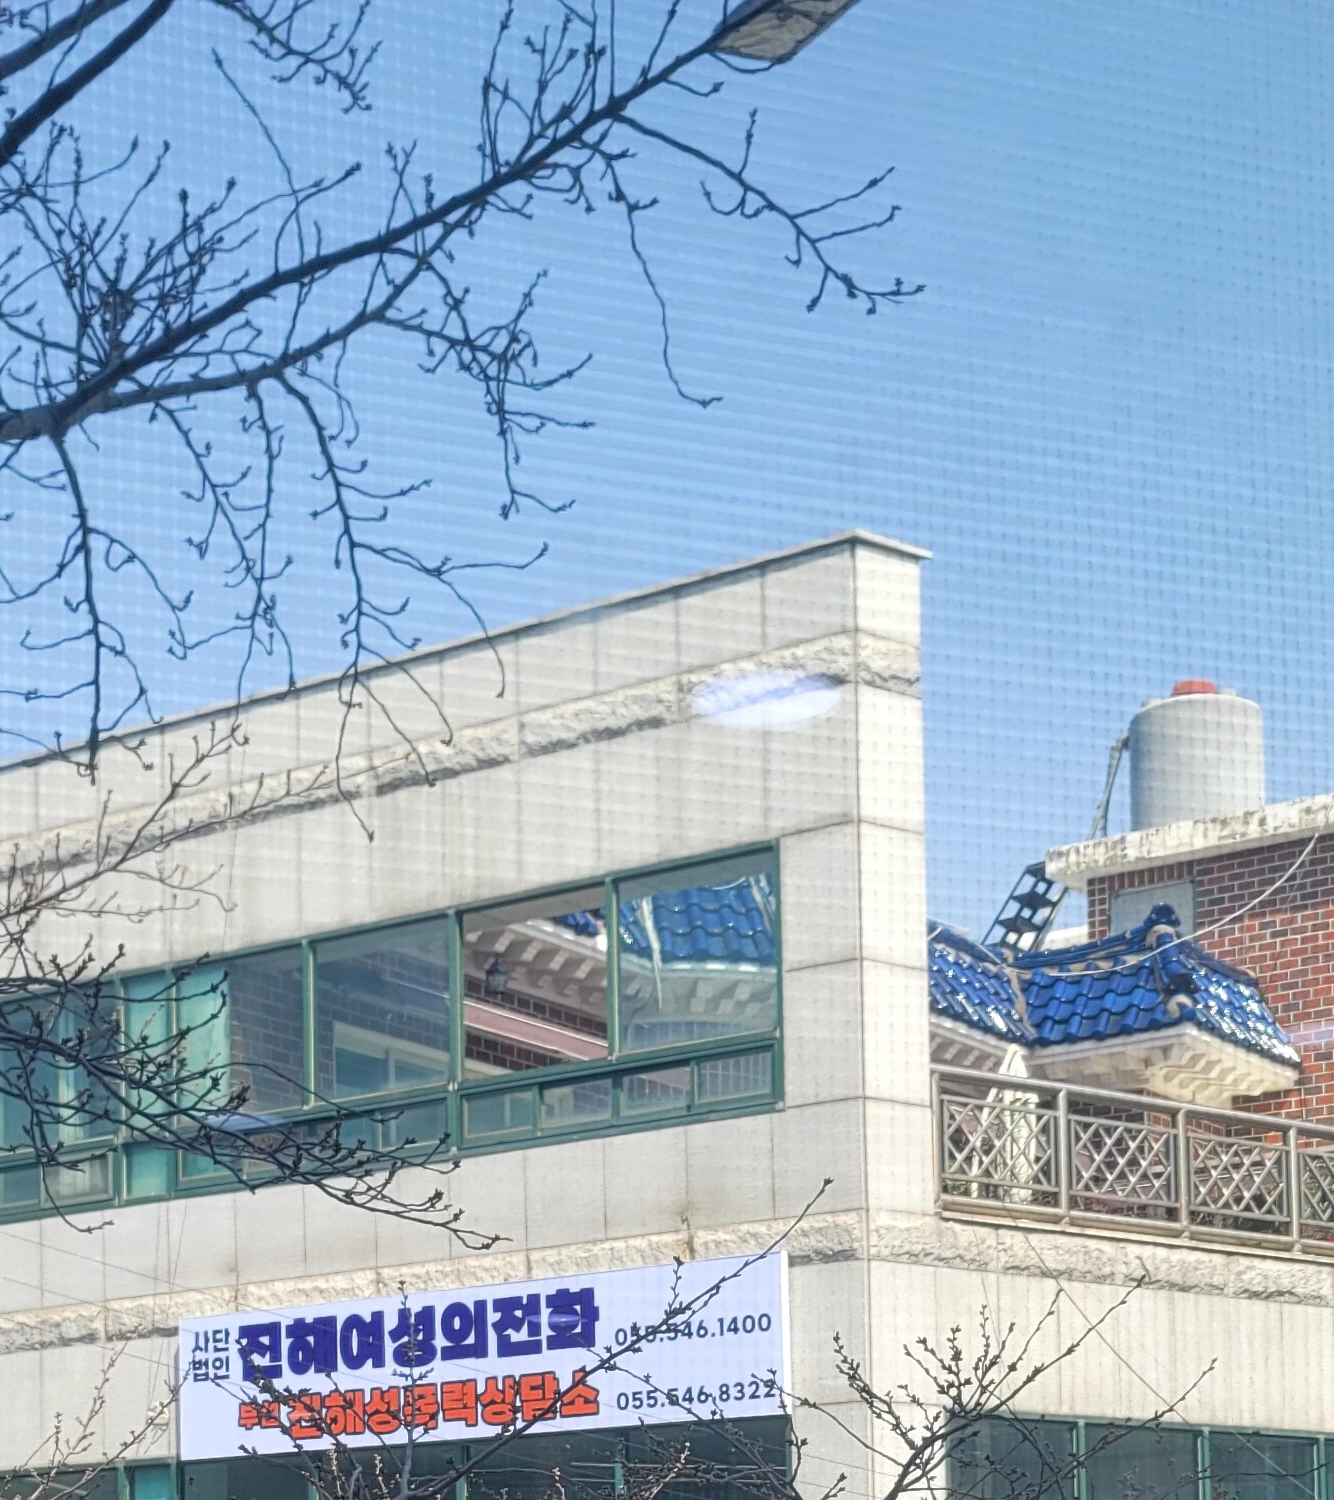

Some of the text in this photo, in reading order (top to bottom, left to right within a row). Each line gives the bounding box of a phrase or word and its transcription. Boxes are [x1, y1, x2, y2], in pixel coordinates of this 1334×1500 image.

[192, 1327, 230, 1353] 사단
[237, 1287, 600, 1381] 진해여성의전화
[192, 1355, 230, 1382] 법인
[616, 1378, 777, 1411] 055.546.8322
